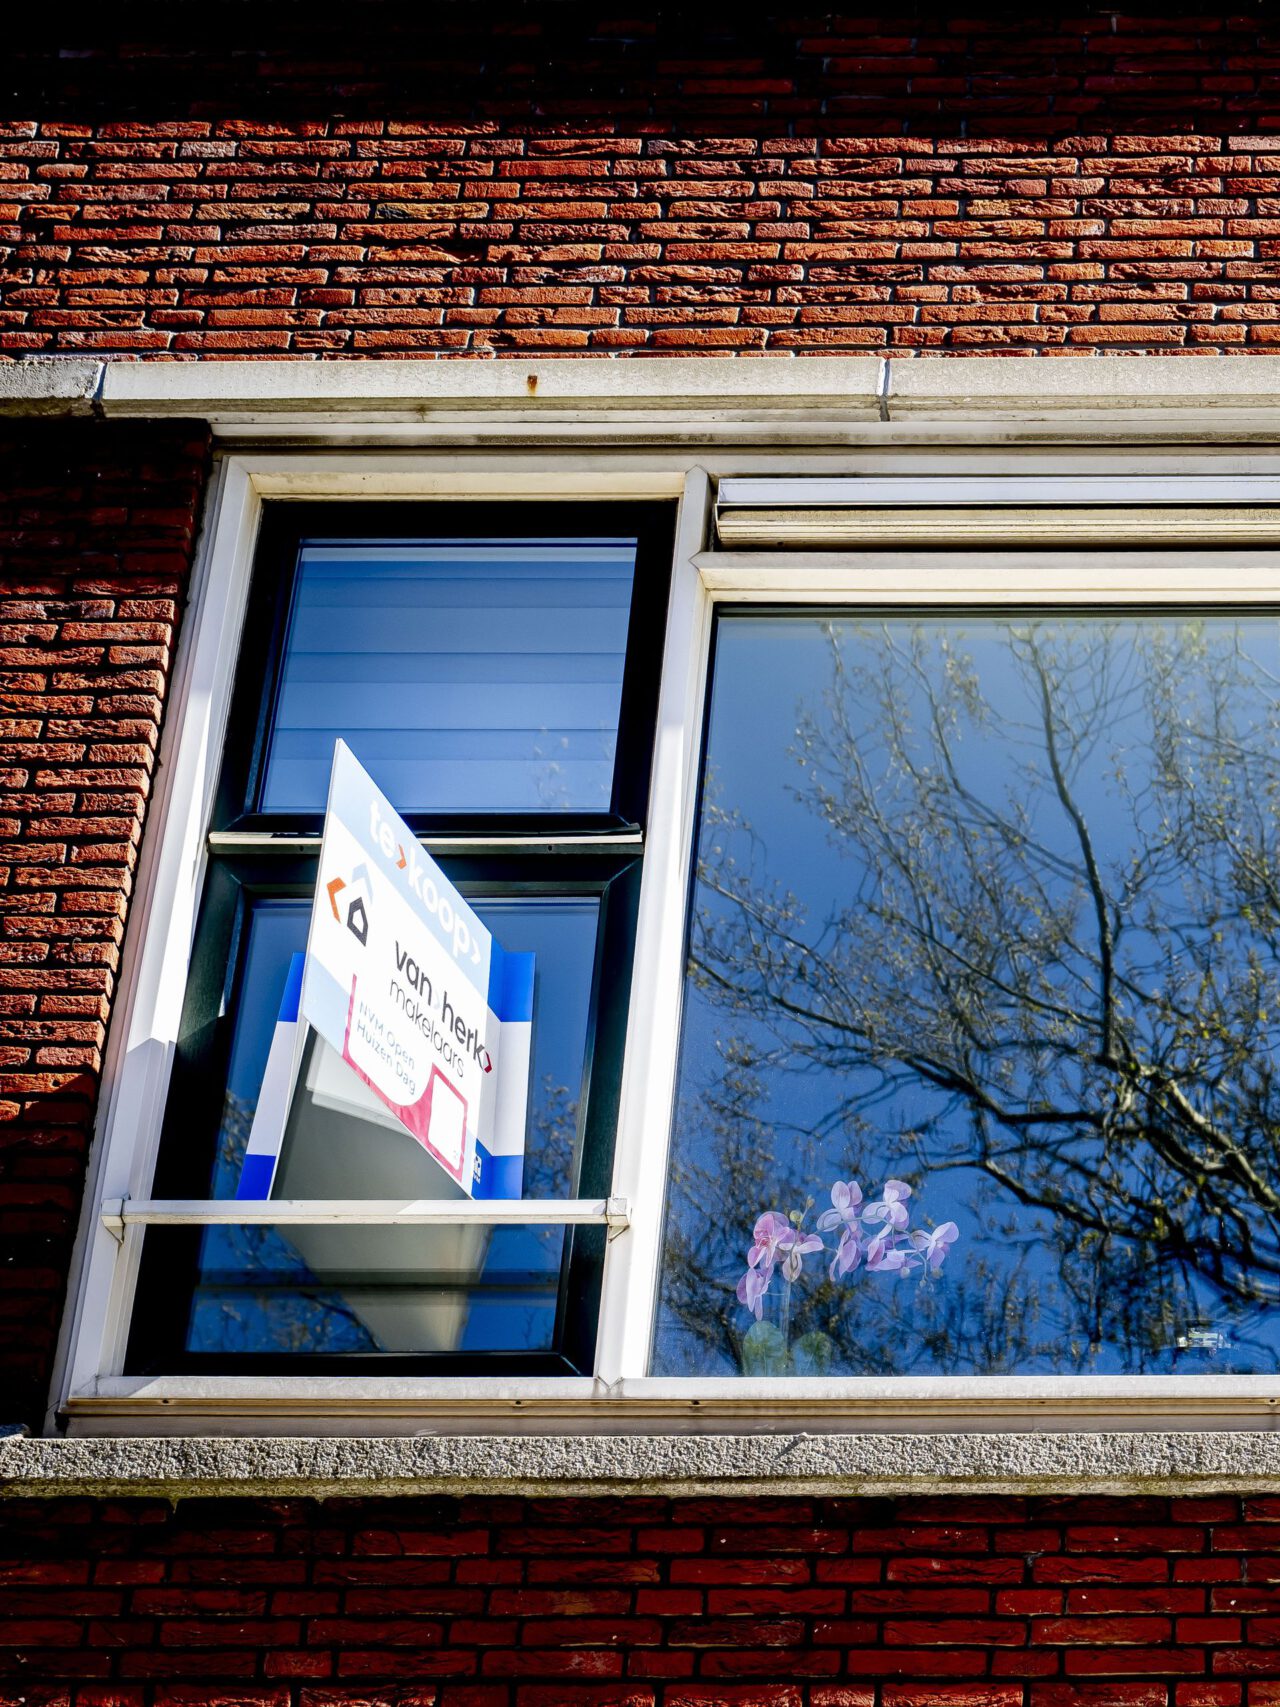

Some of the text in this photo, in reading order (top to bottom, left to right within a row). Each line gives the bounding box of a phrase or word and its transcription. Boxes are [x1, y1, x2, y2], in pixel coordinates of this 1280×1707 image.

[370, 800, 472, 958] te koop
[359, 1001, 415, 1070] NVM Open
[389, 979, 464, 1078] makelaars
[395, 940, 485, 1071] van herk
[356, 1018, 416, 1096] Huizen Dag
